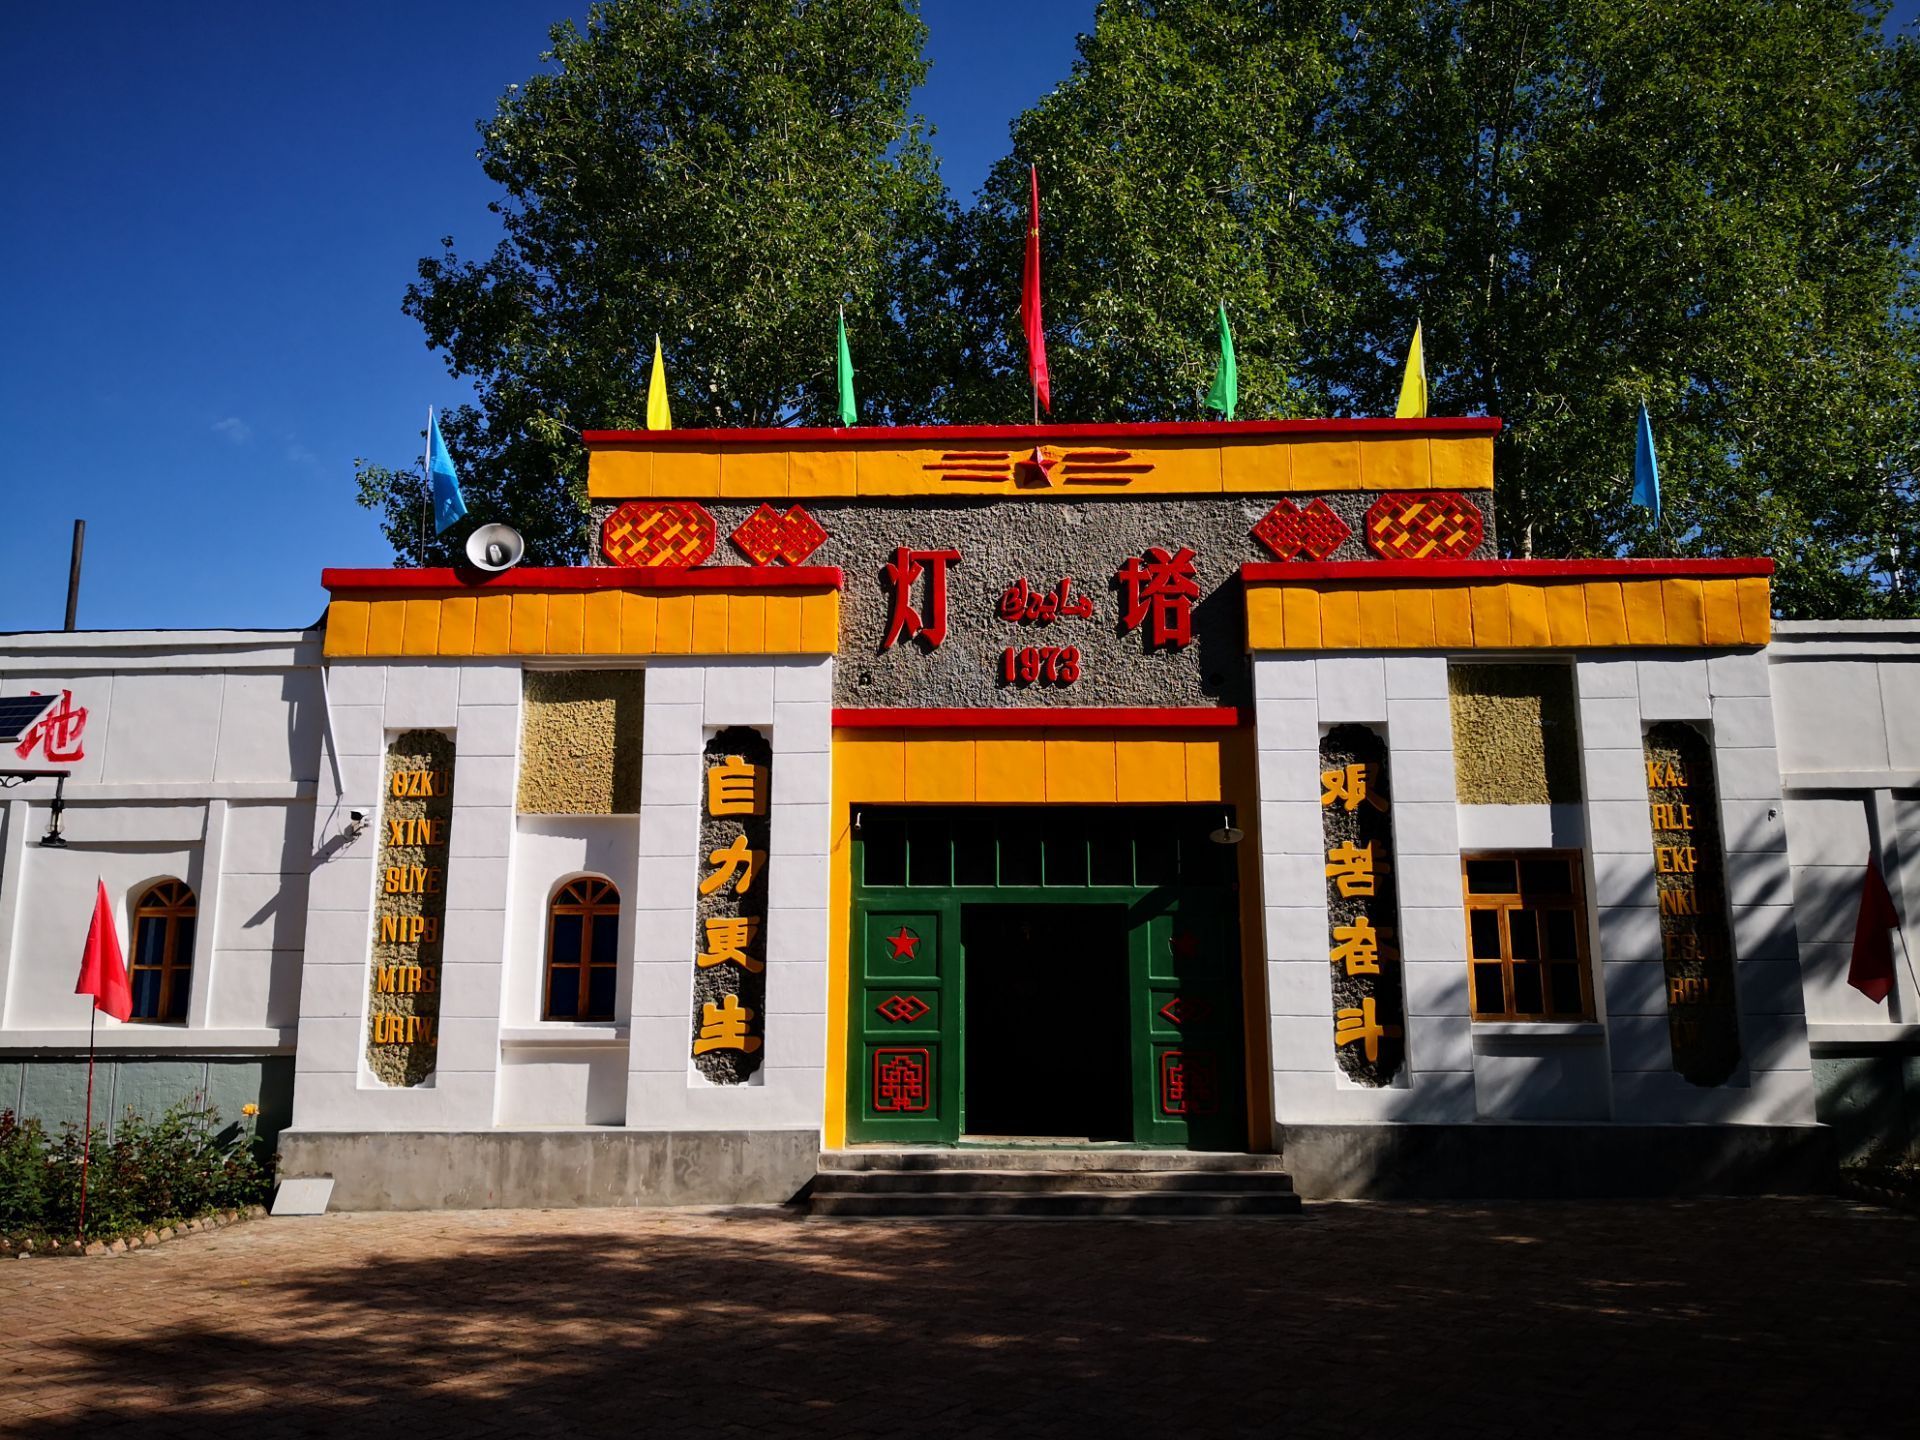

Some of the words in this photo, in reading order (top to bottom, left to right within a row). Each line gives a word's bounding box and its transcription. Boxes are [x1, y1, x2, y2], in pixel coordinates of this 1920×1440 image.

[885, 546, 962, 649] 灯
[1117, 546, 1200, 648] 塔
[1004, 645, 1081, 683] 1973
[693, 755, 767, 1055] 自力更生
[1320, 763, 1400, 1062] 艰苦奋斗
